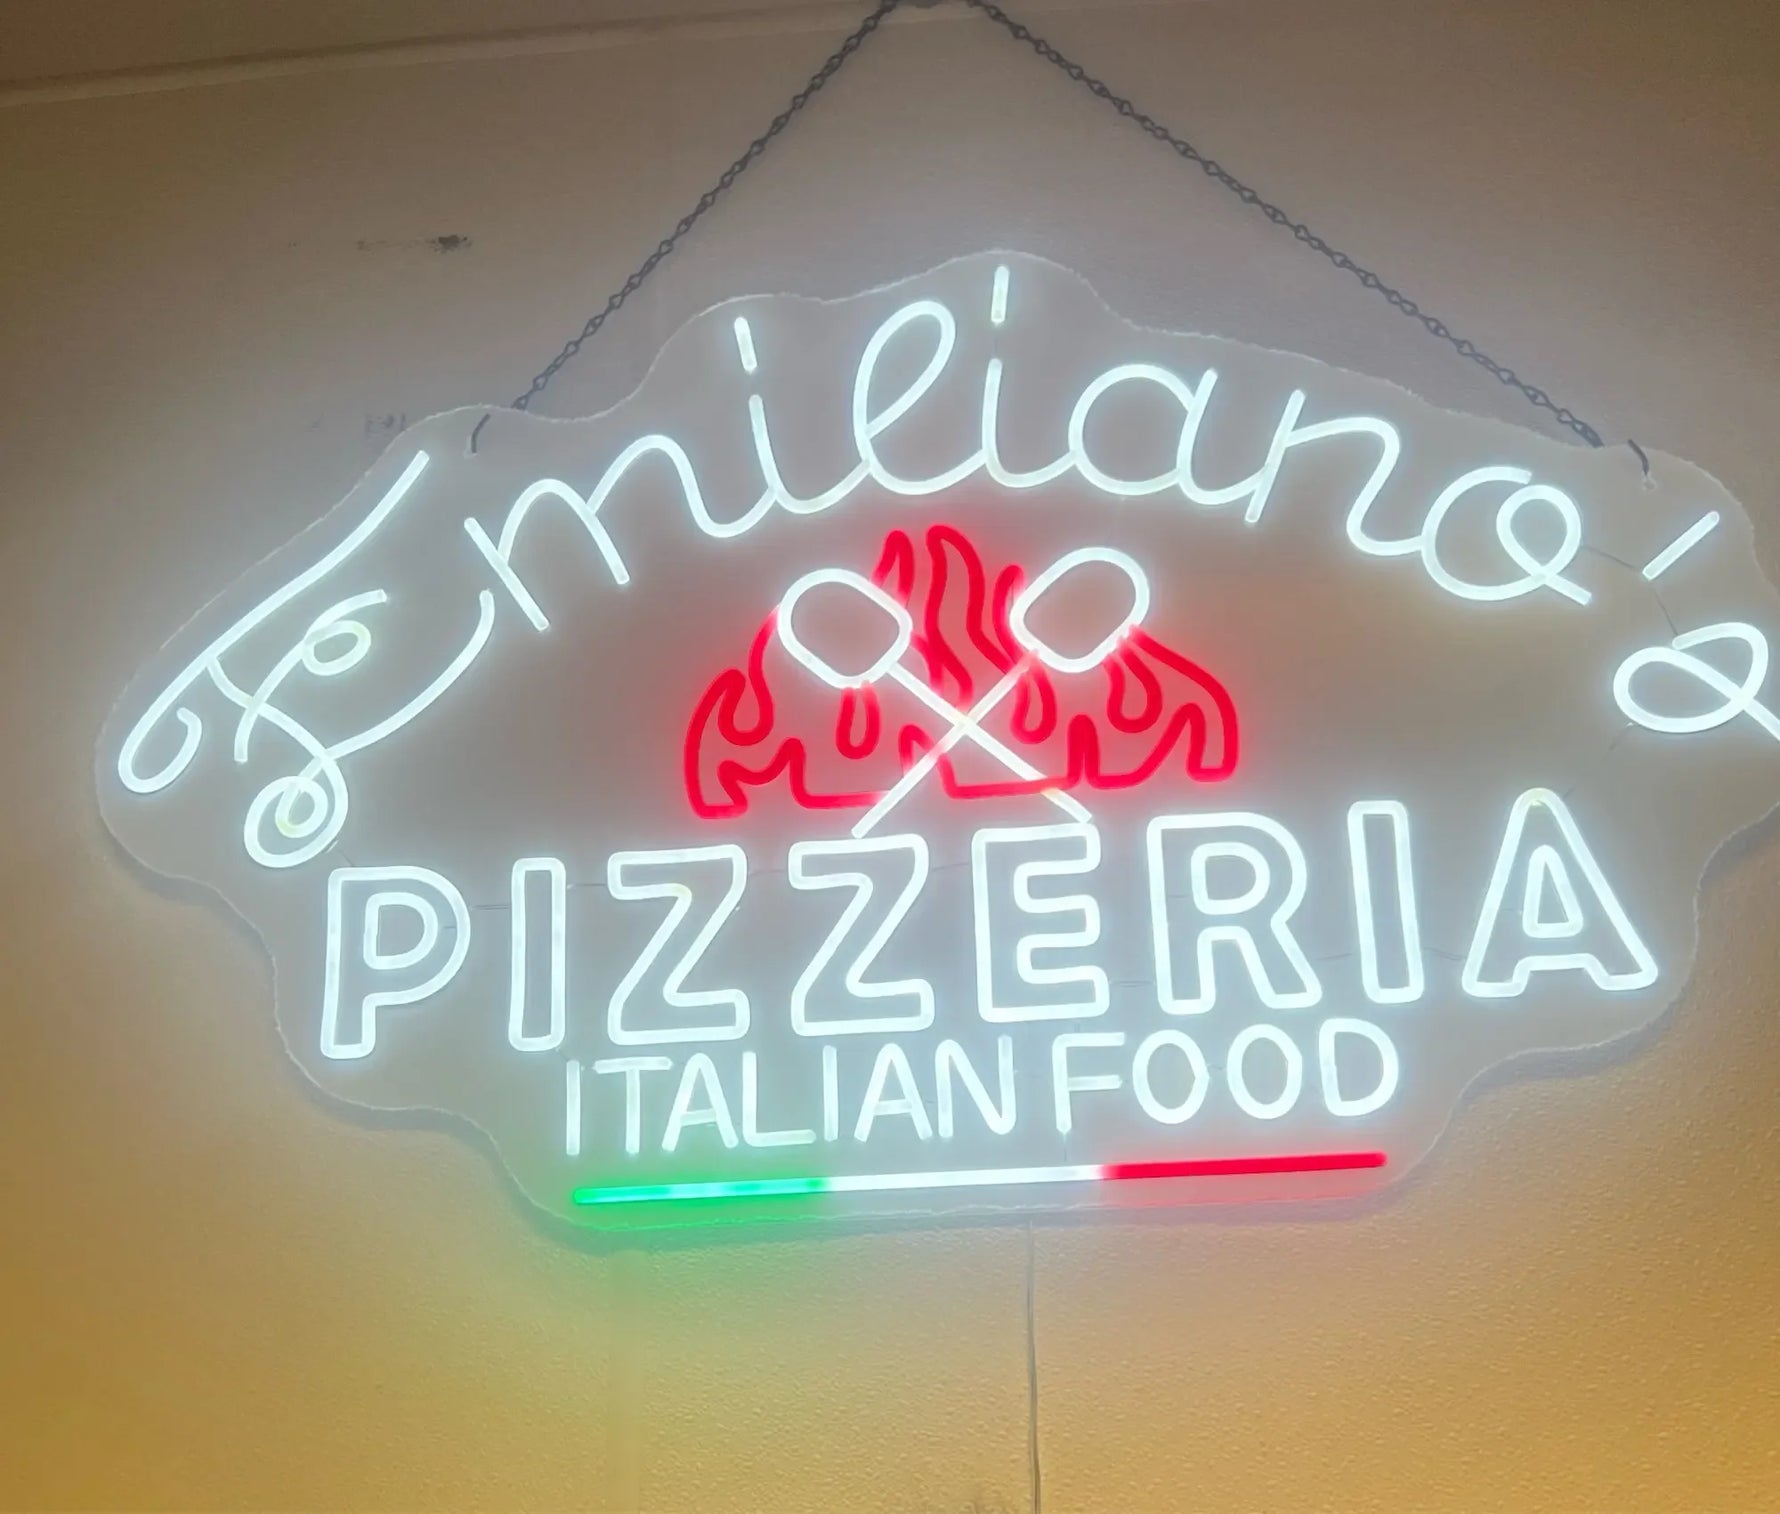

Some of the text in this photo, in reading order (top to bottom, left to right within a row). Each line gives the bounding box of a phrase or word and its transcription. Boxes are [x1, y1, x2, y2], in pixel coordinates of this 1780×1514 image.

[320, 787, 1659, 1059] PIZZERIA
[565, 1017, 1400, 1156] ITALIAN FOOD
